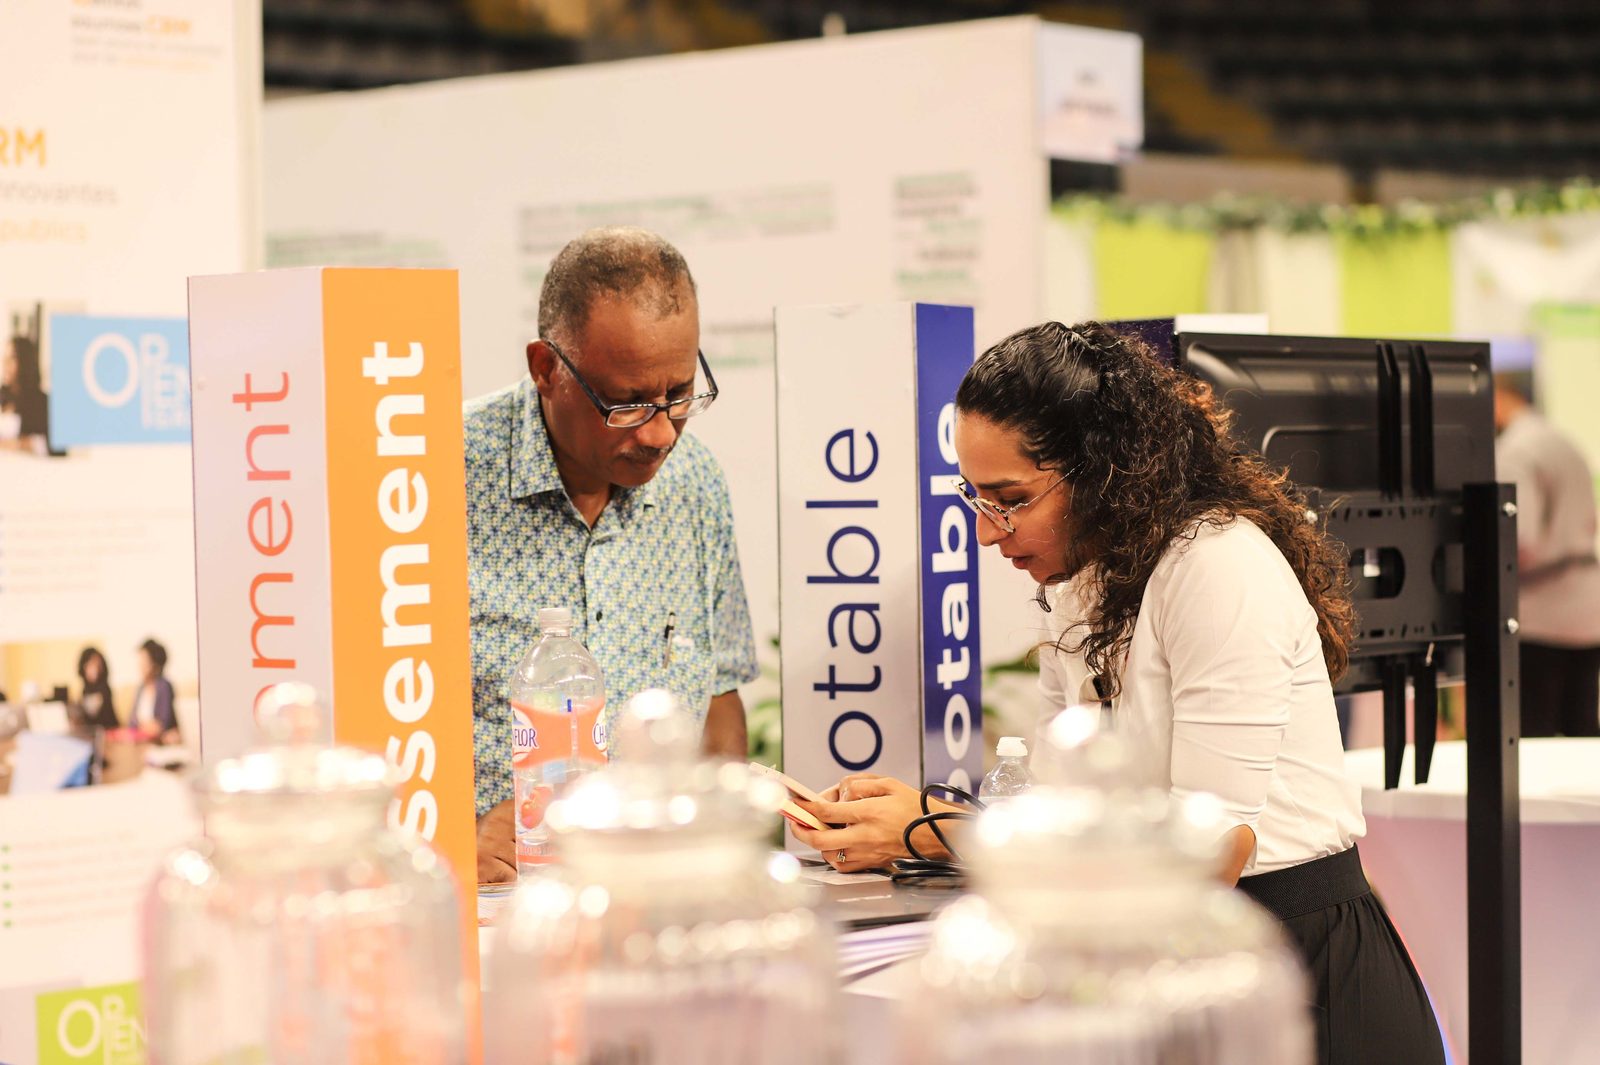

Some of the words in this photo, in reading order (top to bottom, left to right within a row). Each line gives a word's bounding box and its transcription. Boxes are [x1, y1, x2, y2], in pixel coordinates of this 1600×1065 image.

[362, 341, 438, 842] ssement
[806, 429, 882, 771] otable
[512, 728, 537, 747] FLOR
[593, 723, 607, 744] CH
